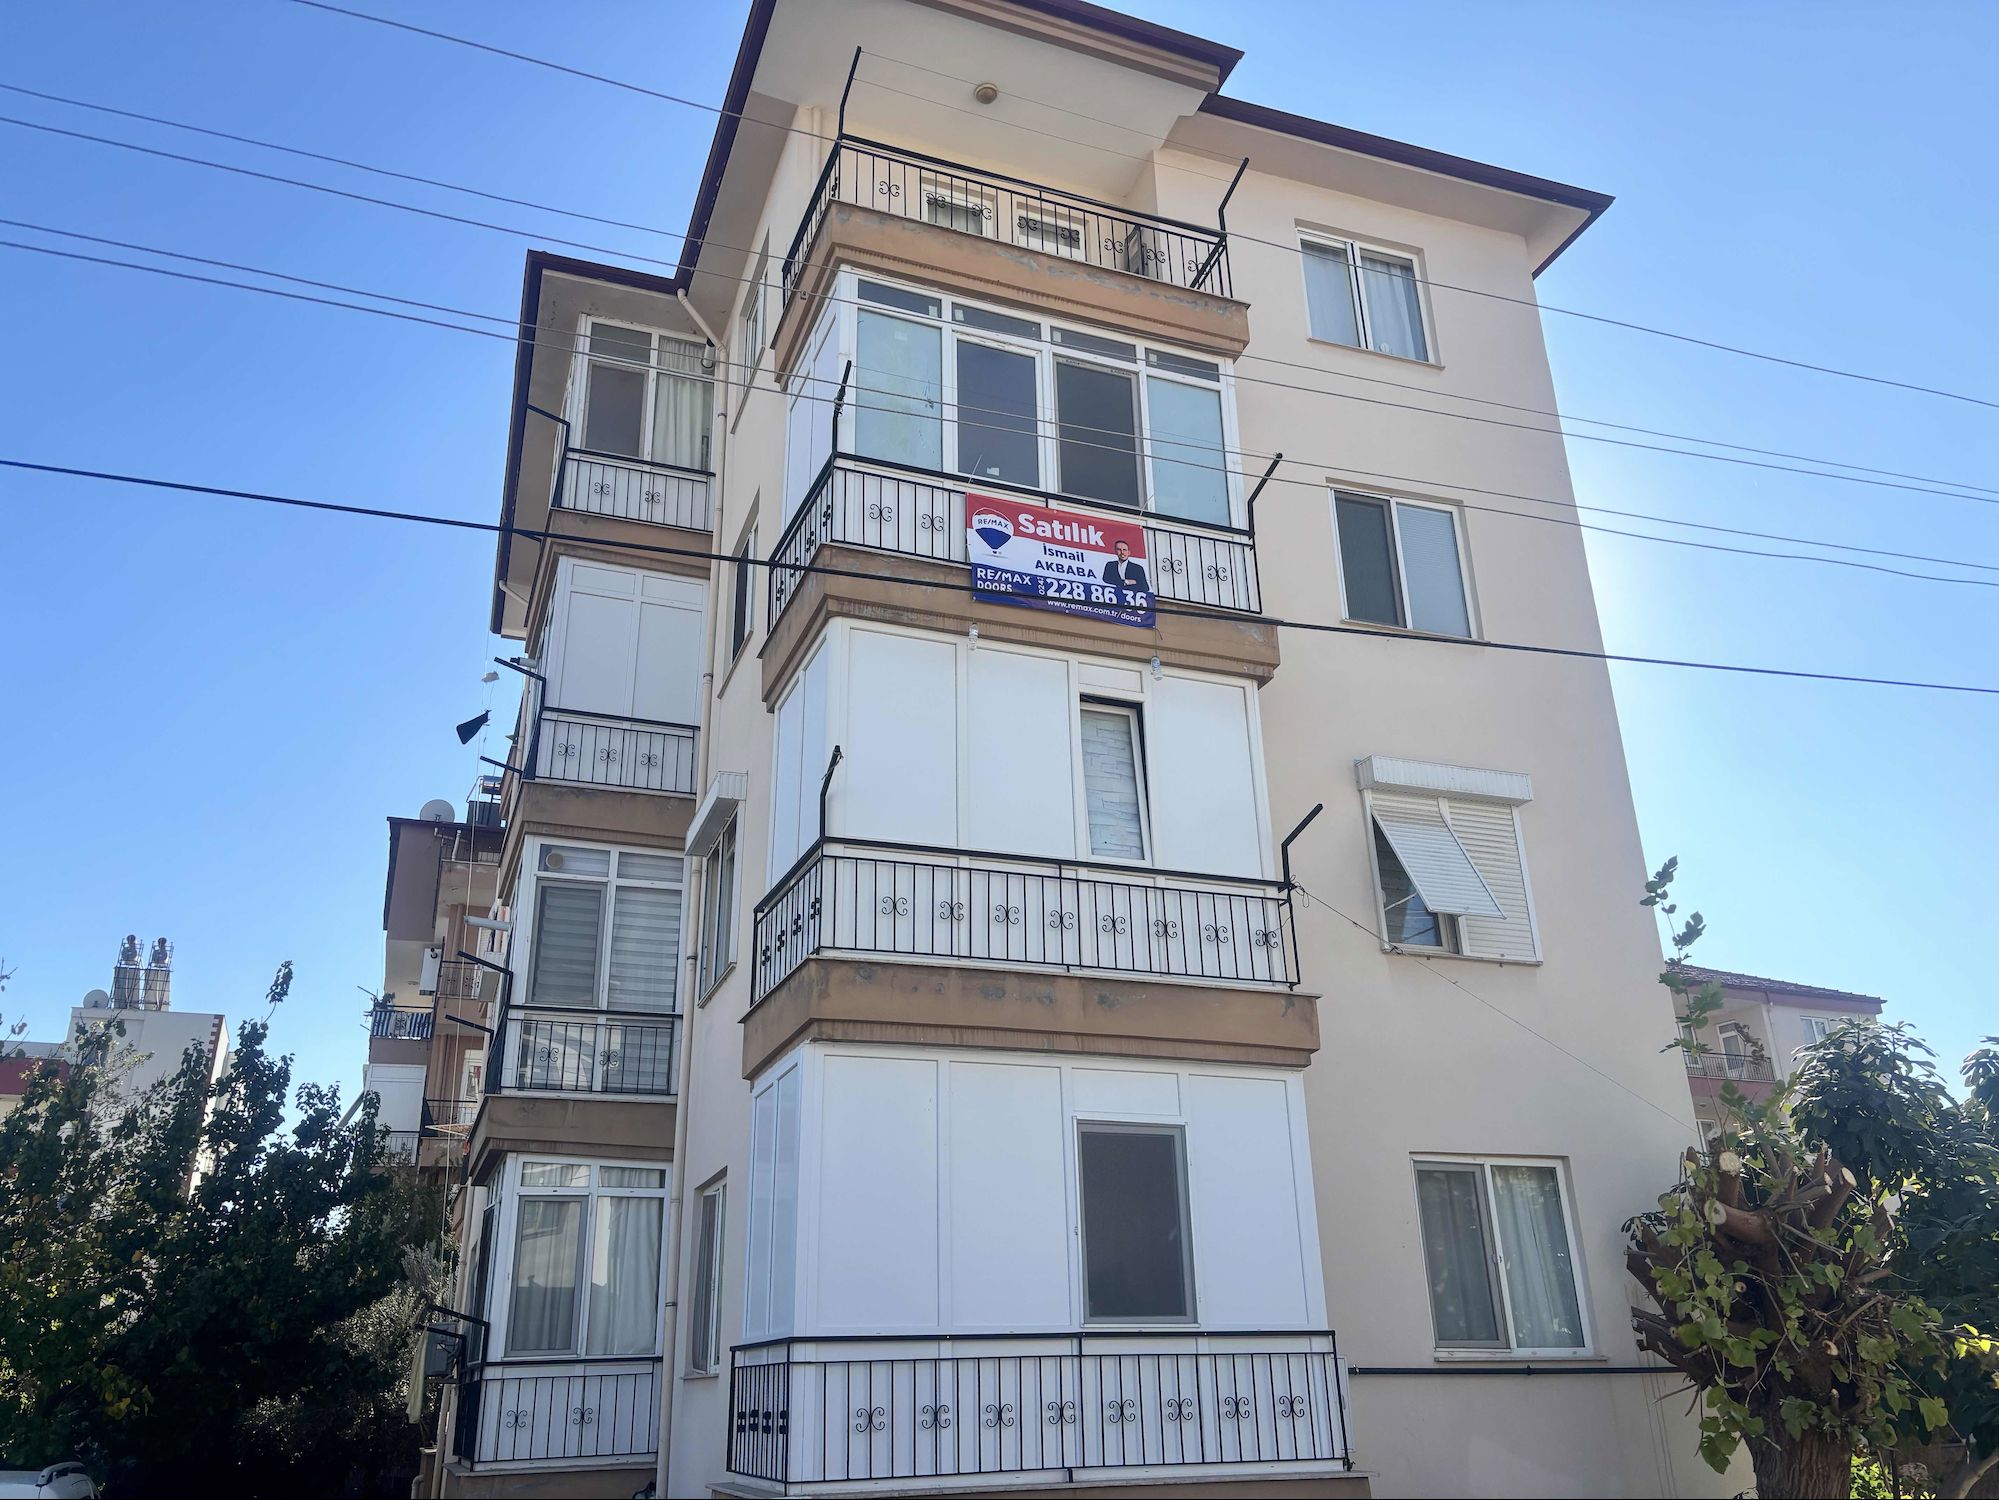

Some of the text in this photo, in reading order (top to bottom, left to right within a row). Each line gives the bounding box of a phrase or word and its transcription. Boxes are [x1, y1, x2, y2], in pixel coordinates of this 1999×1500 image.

[977, 518, 1009, 530] RE/MAX
[1018, 513, 1105, 547] Satılık
[1043, 543, 1084, 562] İsmail
[977, 568, 1032, 586] RE/MAX
[1035, 560, 1096, 579] AKBABA
[977, 580, 1013, 593] DOORS
[1046, 577, 1085, 601] 228
[1091, 585, 1117, 604] 86
[1123, 590, 1147, 614] 36
[1047, 600, 1141, 623] www.remax.com.tr/doors
